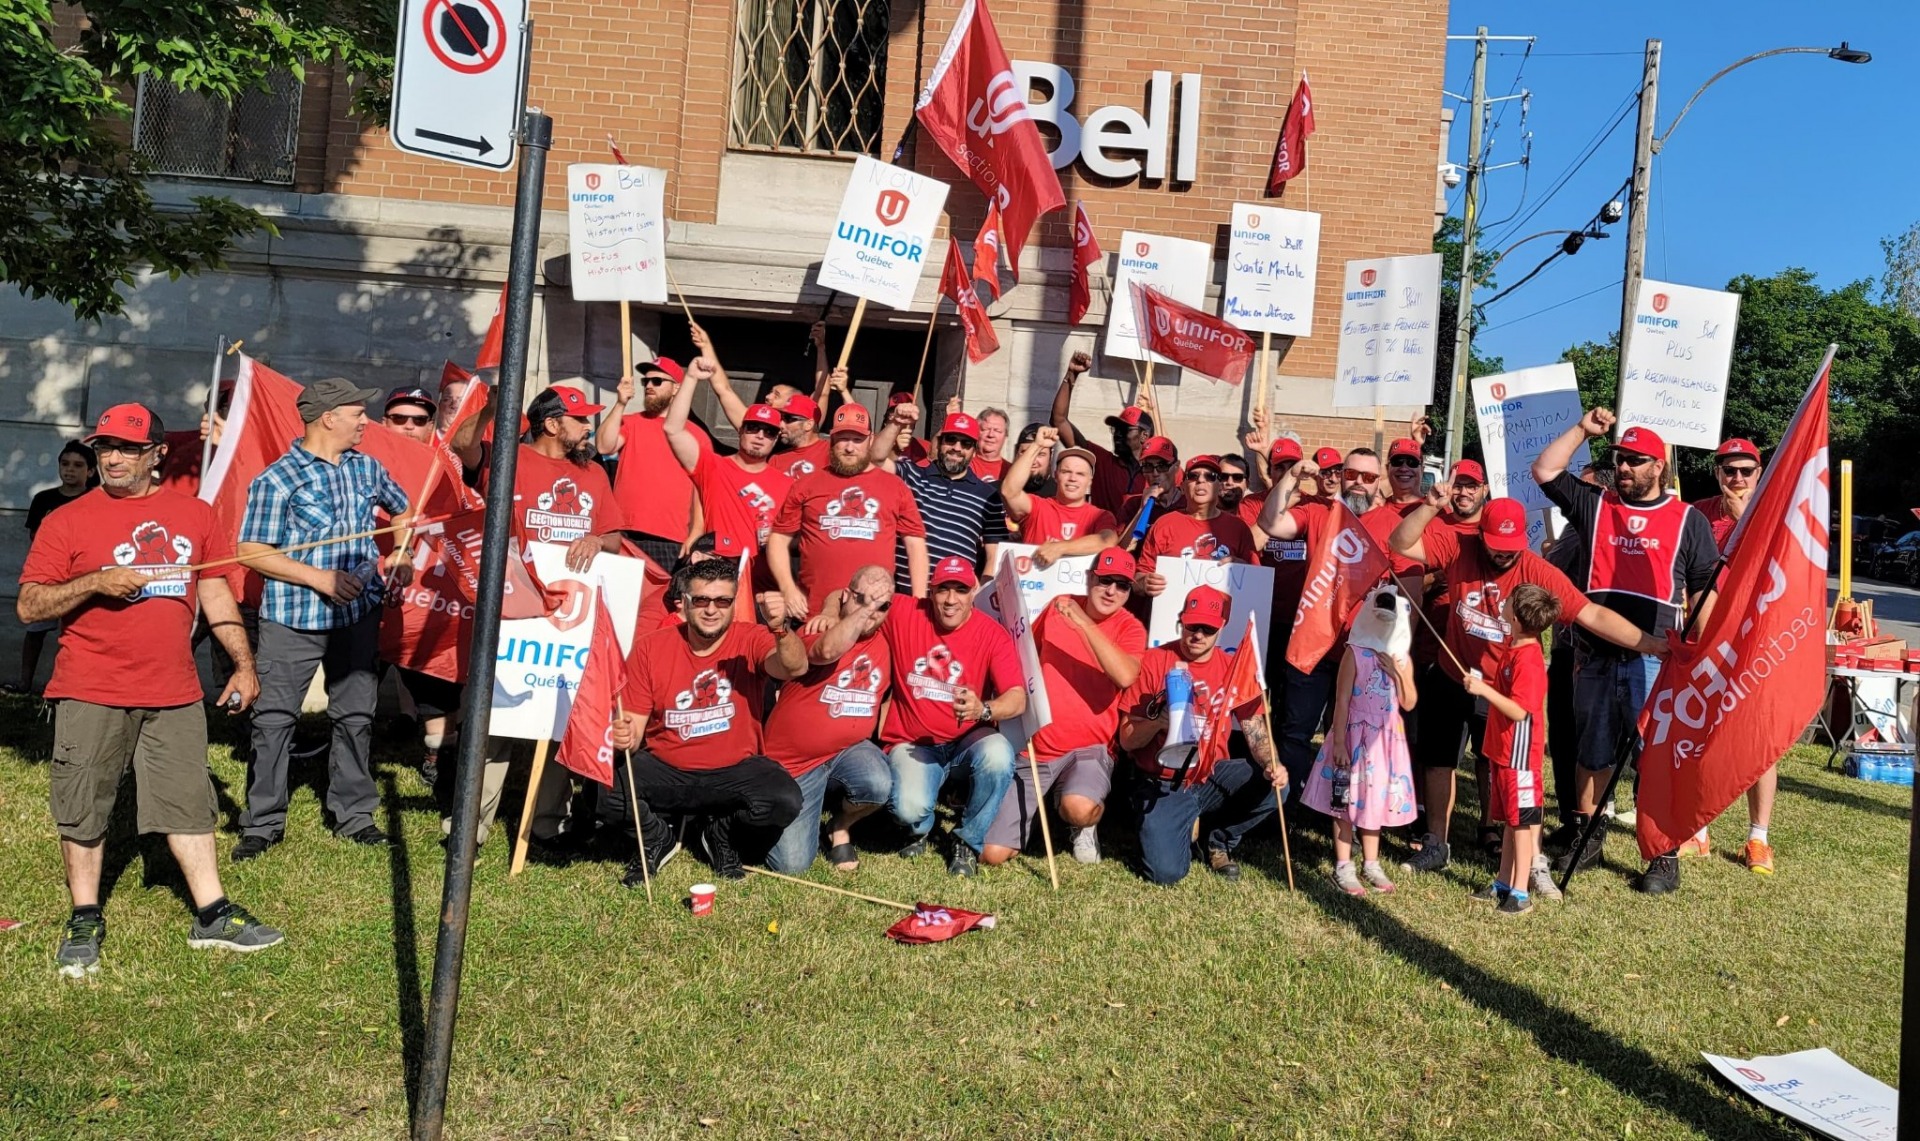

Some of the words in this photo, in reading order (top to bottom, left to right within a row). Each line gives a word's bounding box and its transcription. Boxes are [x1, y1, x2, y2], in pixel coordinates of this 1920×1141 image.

[1011, 60, 1200, 182] Bell
[618, 169, 651, 190] Bell
[572, 193, 614, 203] UNIFOR
[837, 221, 923, 263] UNIFOR
[1234, 230, 1271, 241] UNIFOR
[856, 250, 893, 269] Québec
[1121, 258, 1159, 270] UNIFOR
[1233, 252, 1264, 274] Santé
[1637, 314, 1679, 329] UNIFOR
[1173, 336, 1204, 351] Québec
[1175, 318, 1247, 352] UNIFOR
[1666, 340, 1693, 360] PLUS
[1480, 401, 1523, 416] UNIFOR
[1485, 408, 1570, 445] FORMATION
[1608, 535, 1659, 549] UNIFOR
[1183, 560, 1246, 590] NON
[692, 721, 728, 735] UNIFOR
[1742, 1079, 1804, 1092] UNIFOR
